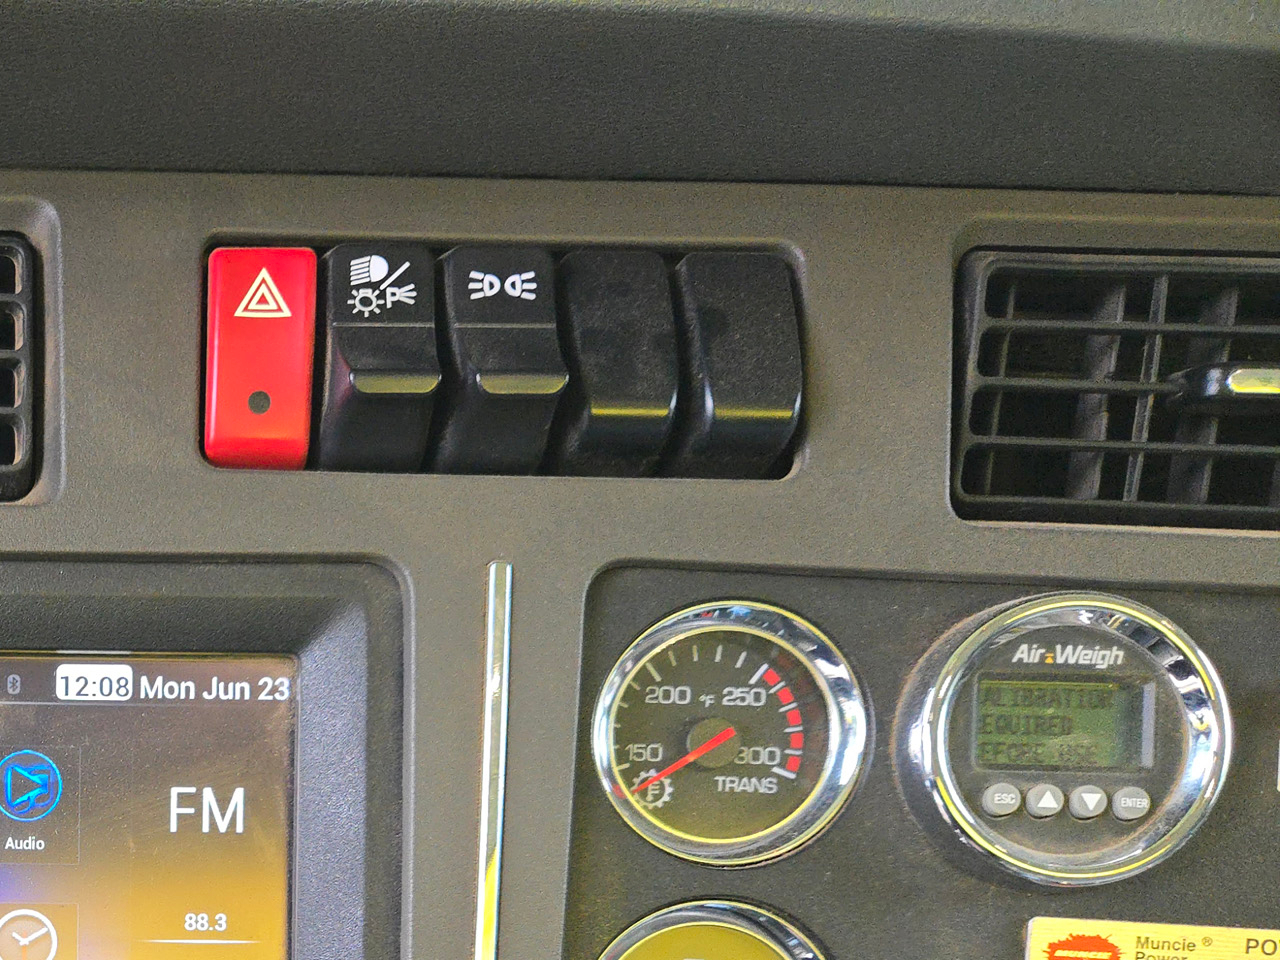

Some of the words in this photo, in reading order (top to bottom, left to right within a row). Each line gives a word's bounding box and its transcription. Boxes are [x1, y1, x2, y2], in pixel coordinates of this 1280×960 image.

[59, 675, 130, 697] 12:08
[140, 675, 195, 699] Mon
[203, 677, 250, 700] Jun
[258, 677, 291, 700] 23
[645, 687, 691, 705] 200
[722, 688, 767, 706] 250
[625, 743, 663, 761] 150
[734, 746, 780, 765] 300
[715, 776, 777, 793] TRANS
[994, 793, 1016, 804] ESC
[1120, 797, 1148, 808] ENTER
[170, 787, 245, 833] FM
[5, 837, 45, 851] Audio
[184, 913, 227, 931] 88.3
[1136, 936, 1196, 952] Muncie
[1245, 938, 1280, 956] PO
